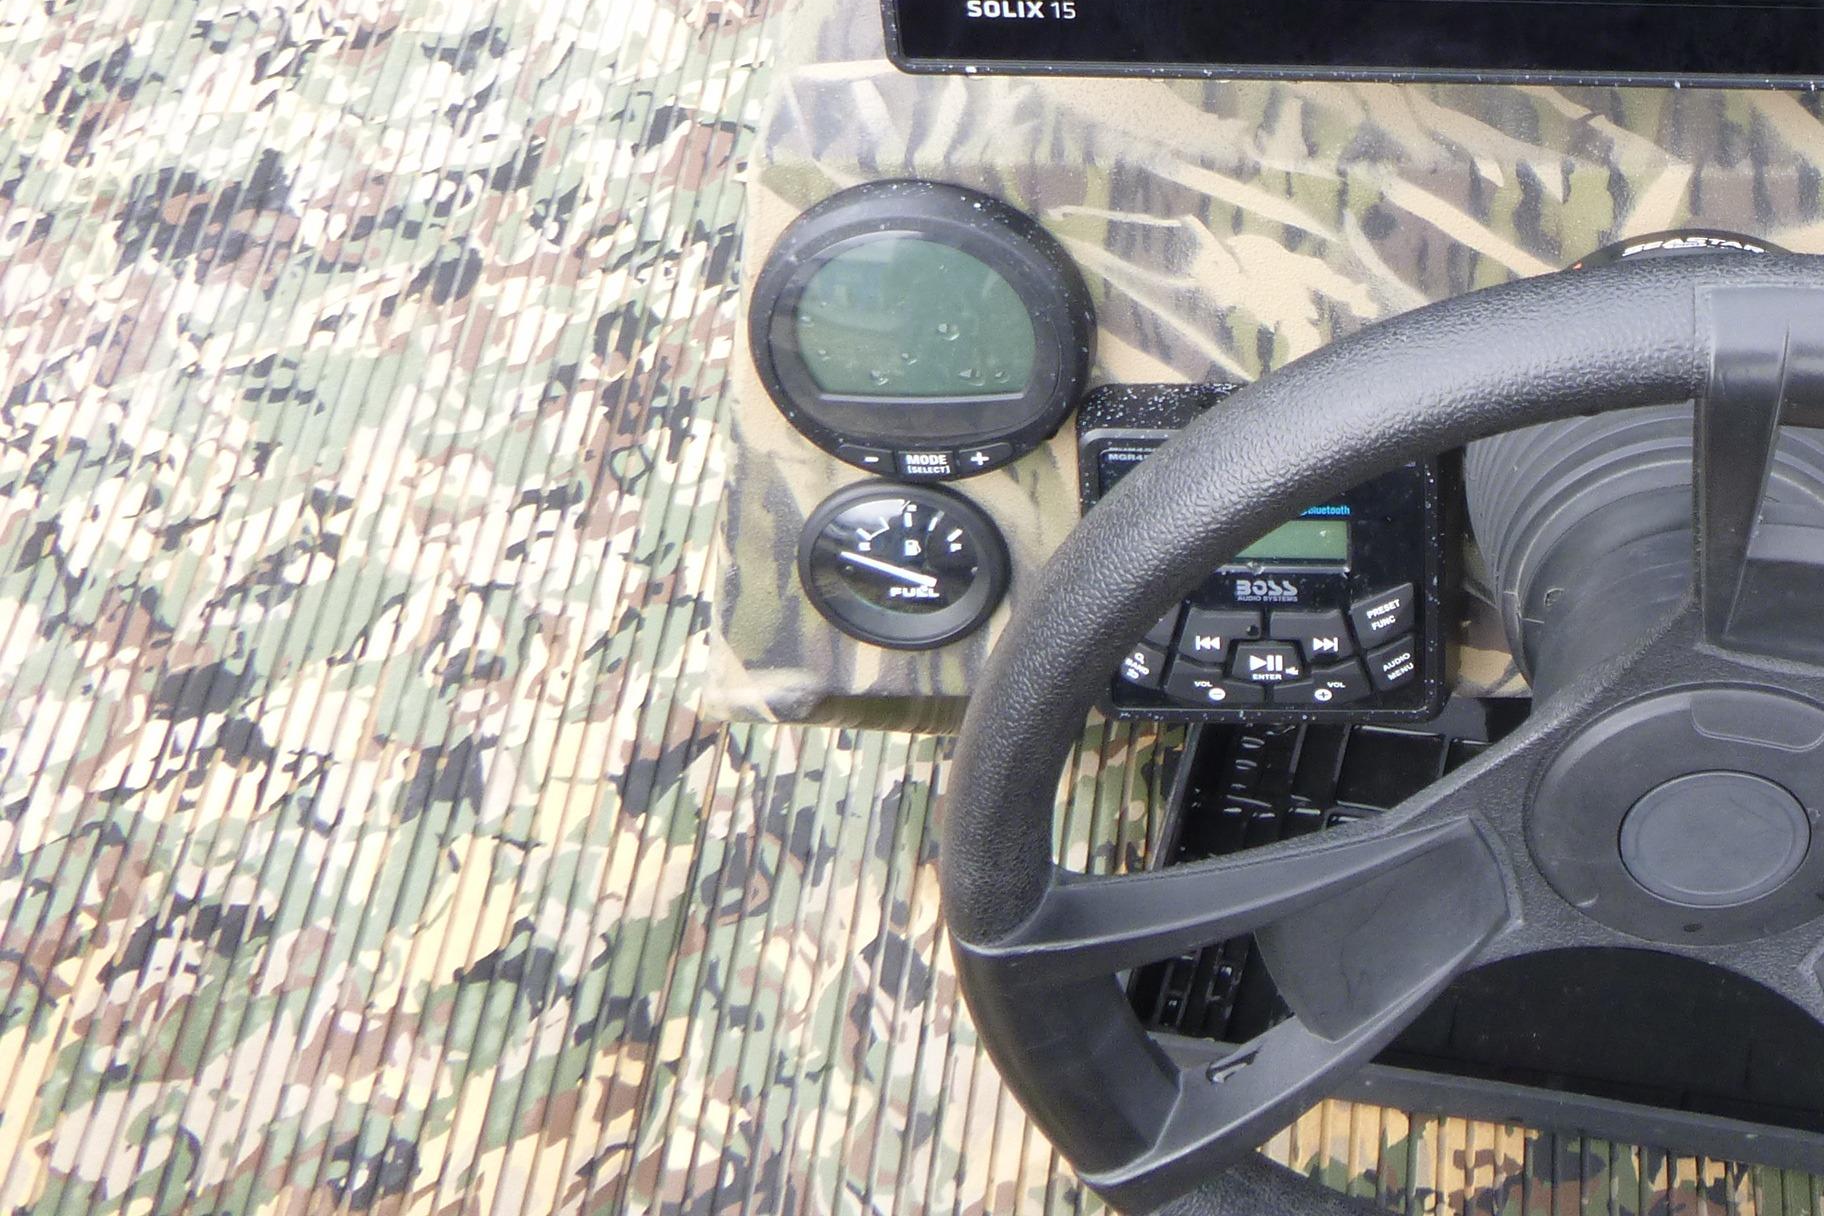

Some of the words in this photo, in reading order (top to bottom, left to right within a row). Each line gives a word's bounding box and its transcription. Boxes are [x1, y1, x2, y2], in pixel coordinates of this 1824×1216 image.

[966, 0, 1045, 18] SOLIX
[1050, 1, 1076, 19] 15
[906, 454, 948, 465] MODE
[889, 586, 940, 598] FUEL
[1236, 580, 1298, 596] BOSS
[1366, 599, 1400, 619] PRESET
[1371, 615, 1396, 631] FUNC
[1383, 652, 1411, 672] AUDIO
[1387, 662, 1414, 681] MENU
